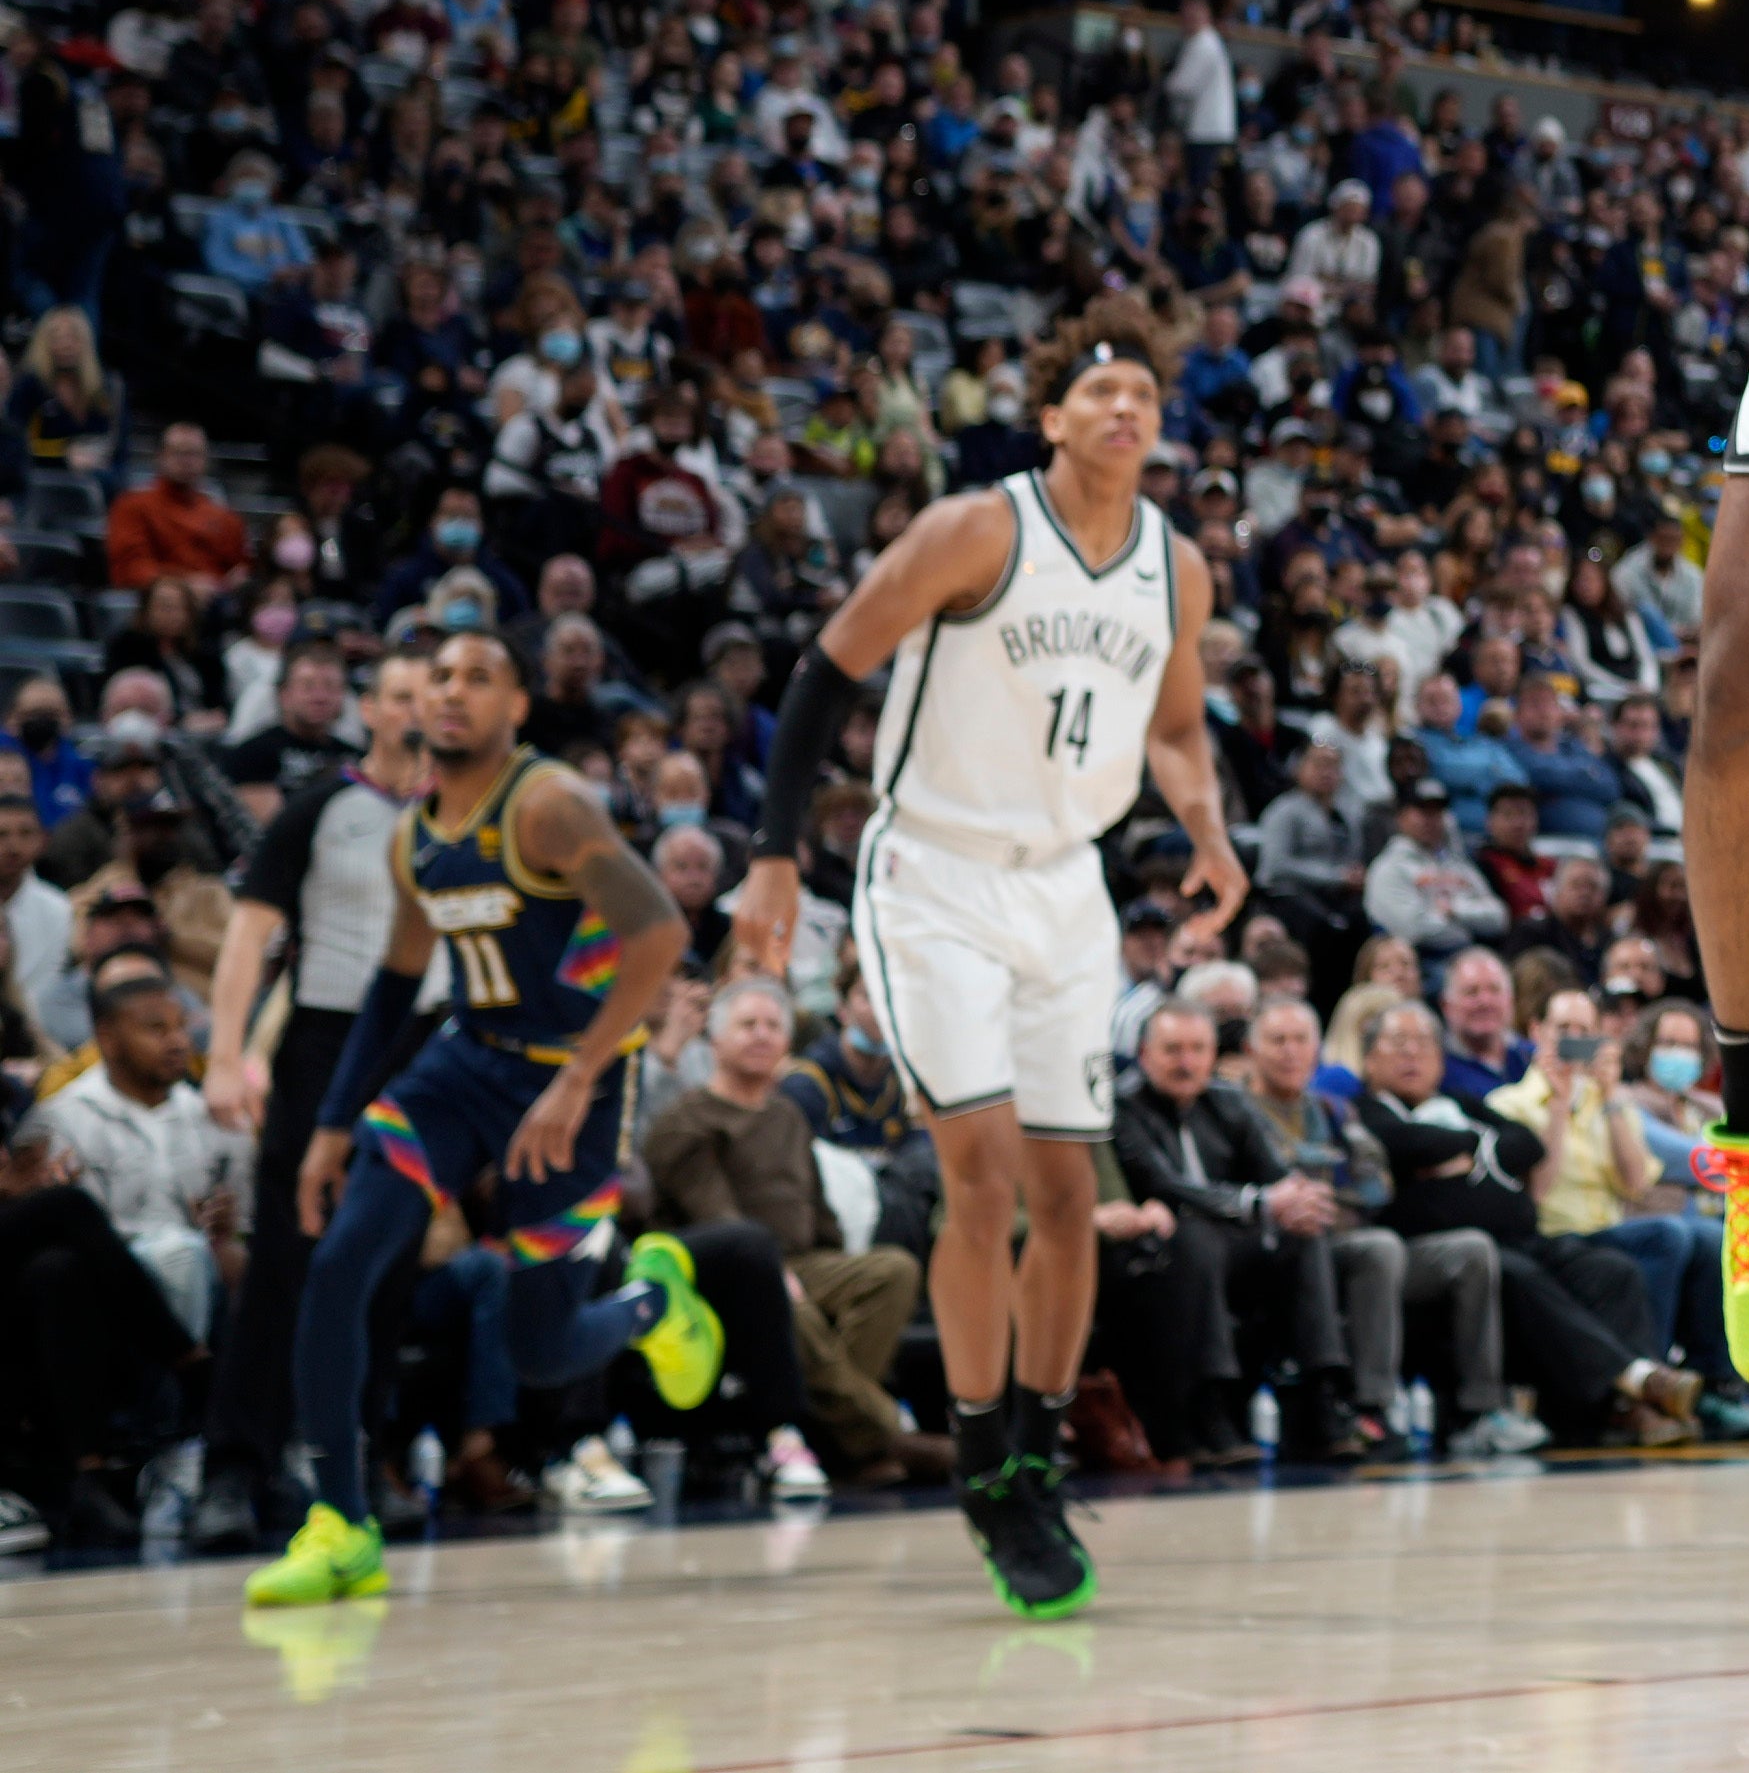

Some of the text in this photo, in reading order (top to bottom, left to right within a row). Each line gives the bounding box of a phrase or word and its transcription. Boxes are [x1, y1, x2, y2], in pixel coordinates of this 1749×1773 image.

[1000, 609, 1156, 683] BROOKLYN
[1044, 683, 1094, 768] 14
[464, 932, 522, 1009] 11
